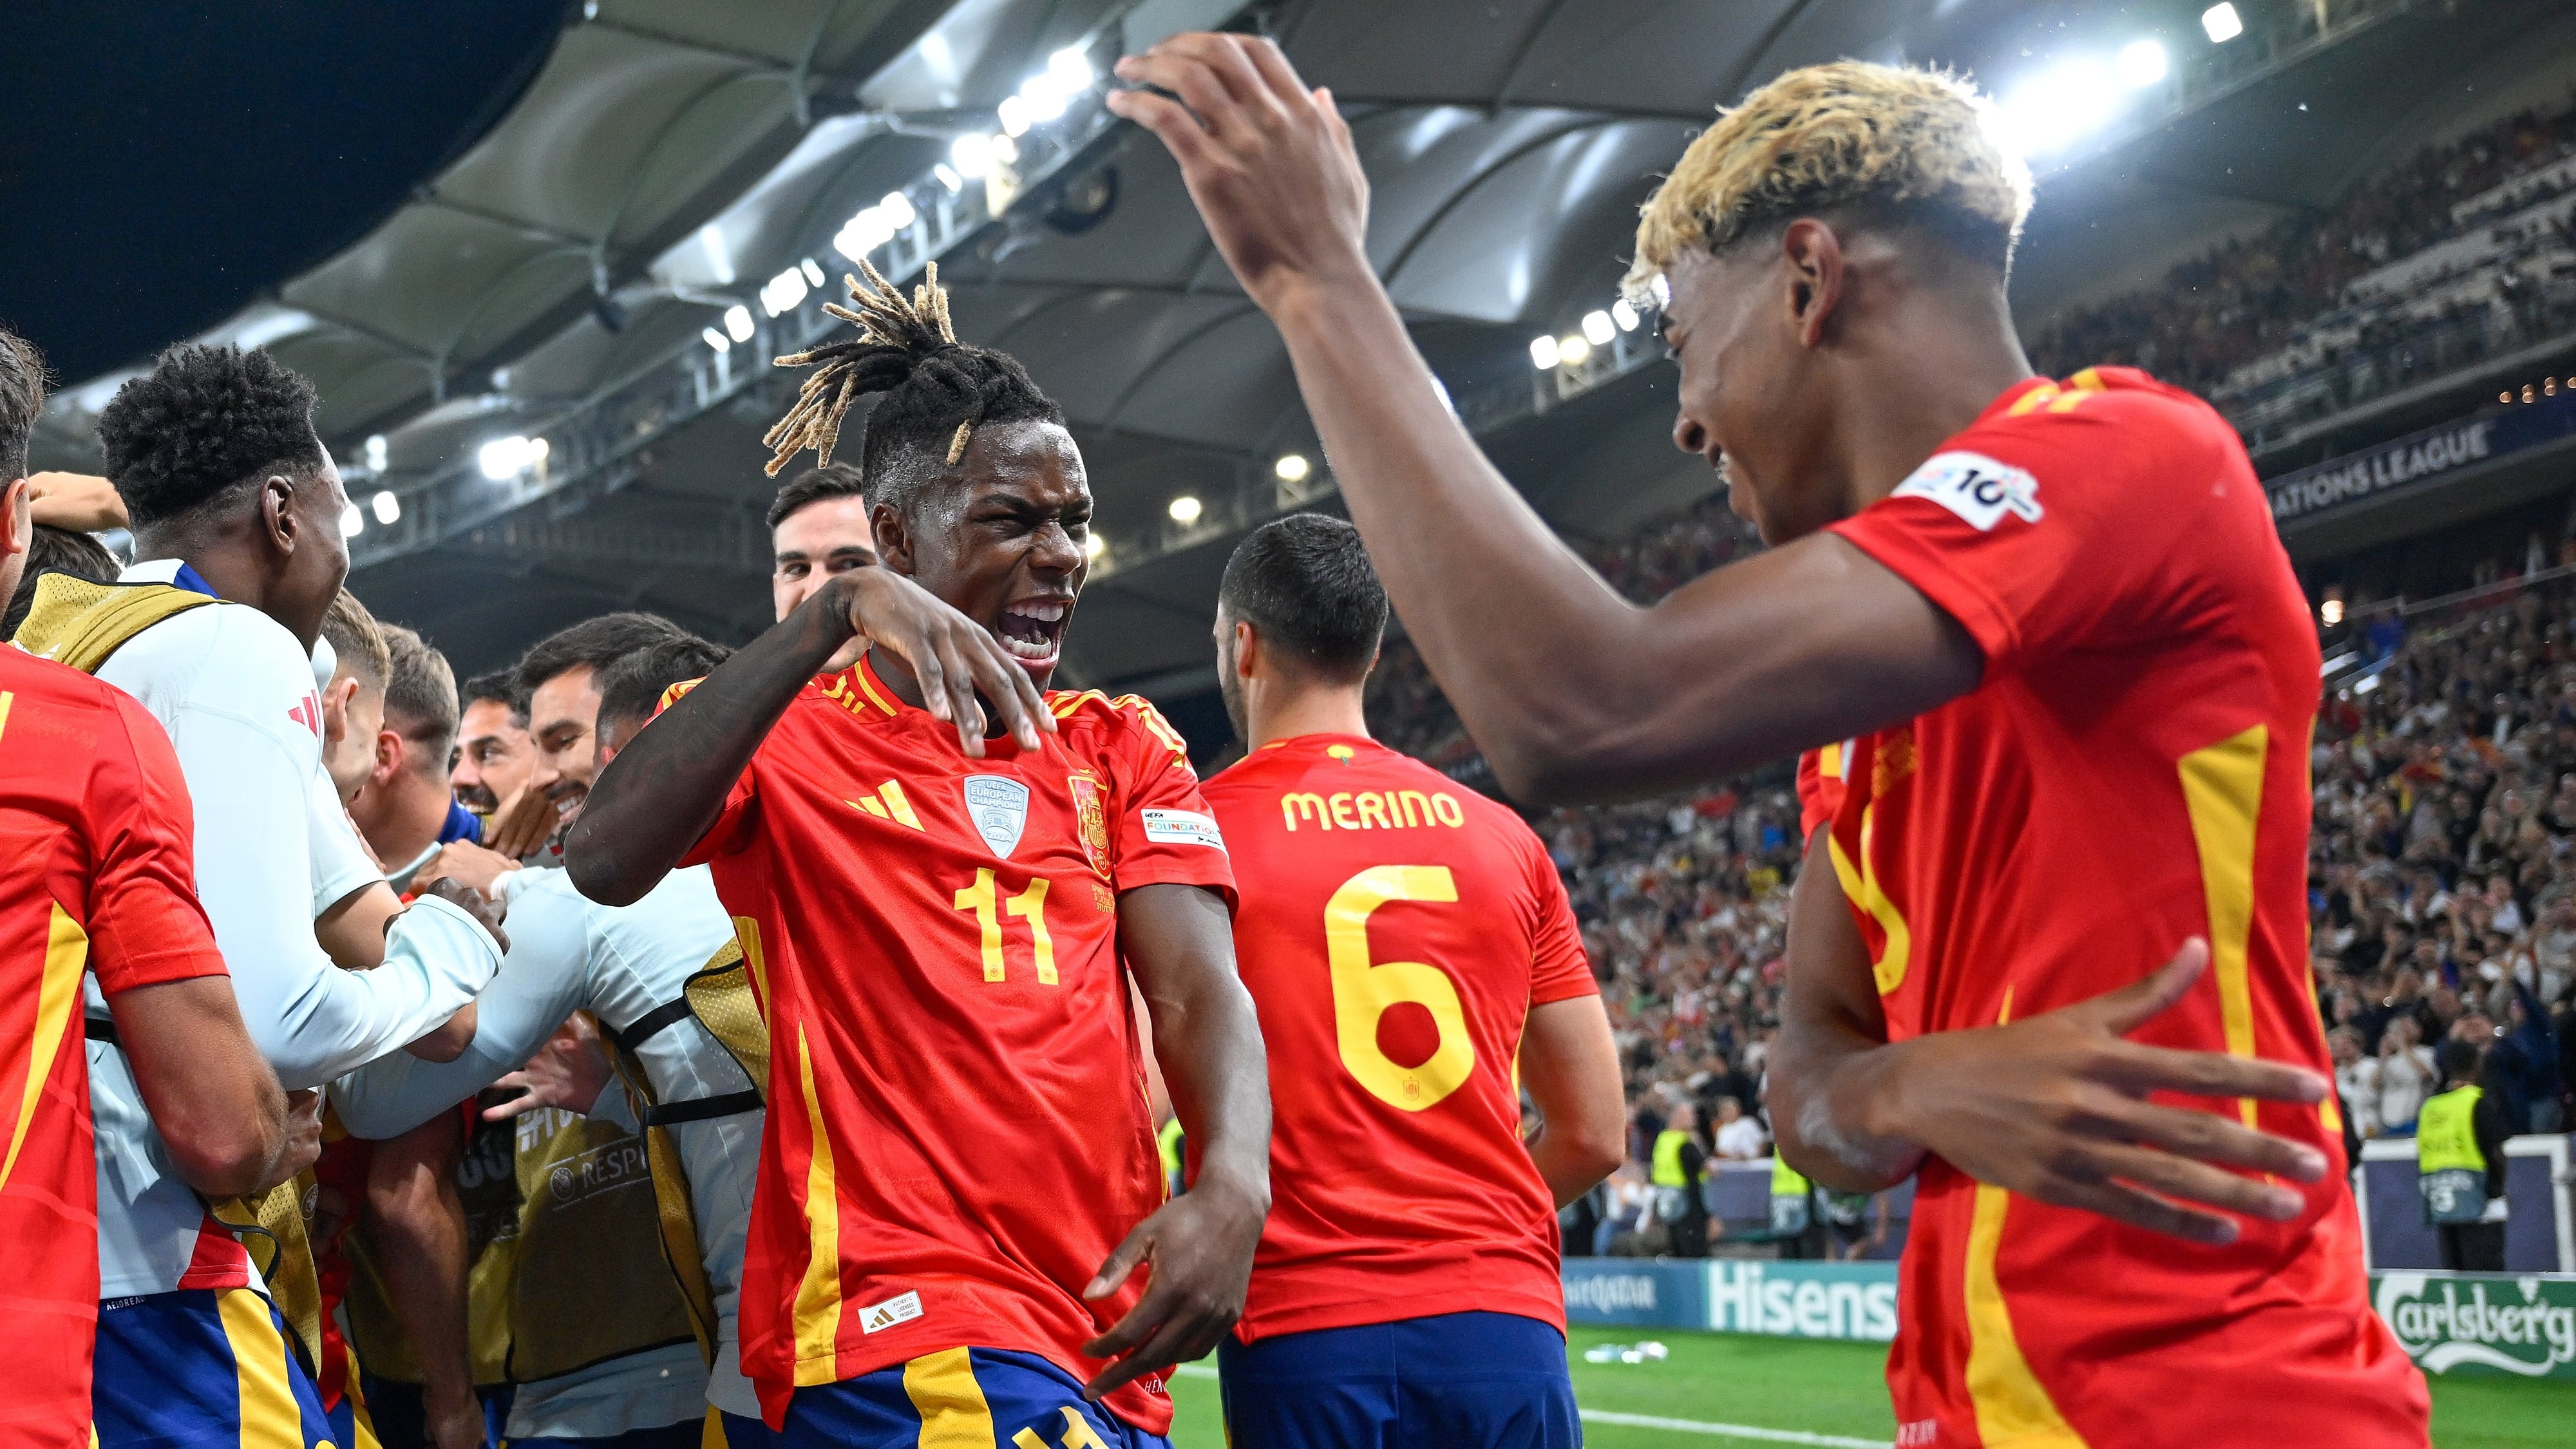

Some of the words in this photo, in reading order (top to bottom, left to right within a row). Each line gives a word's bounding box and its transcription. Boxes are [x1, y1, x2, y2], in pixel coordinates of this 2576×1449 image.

[2272, 460, 2371, 517] ATIONS
[2373, 422, 2490, 486] LEAGUE
[970, 786, 1023, 803] EUROPEAN
[970, 796, 1023, 811] CHAMPIONS
[985, 780, 1007, 791] UEFA
[1147, 822, 1218, 837] FOUNDATION
[1281, 790, 1464, 832] MERINO
[986, 831, 1013, 842] 2024
[954, 867, 1059, 985] 11
[1324, 865, 1475, 1112] 6
[1708, 1261, 1899, 1342] Hisens
[2377, 1275, 2575, 1363] Carlsberg
